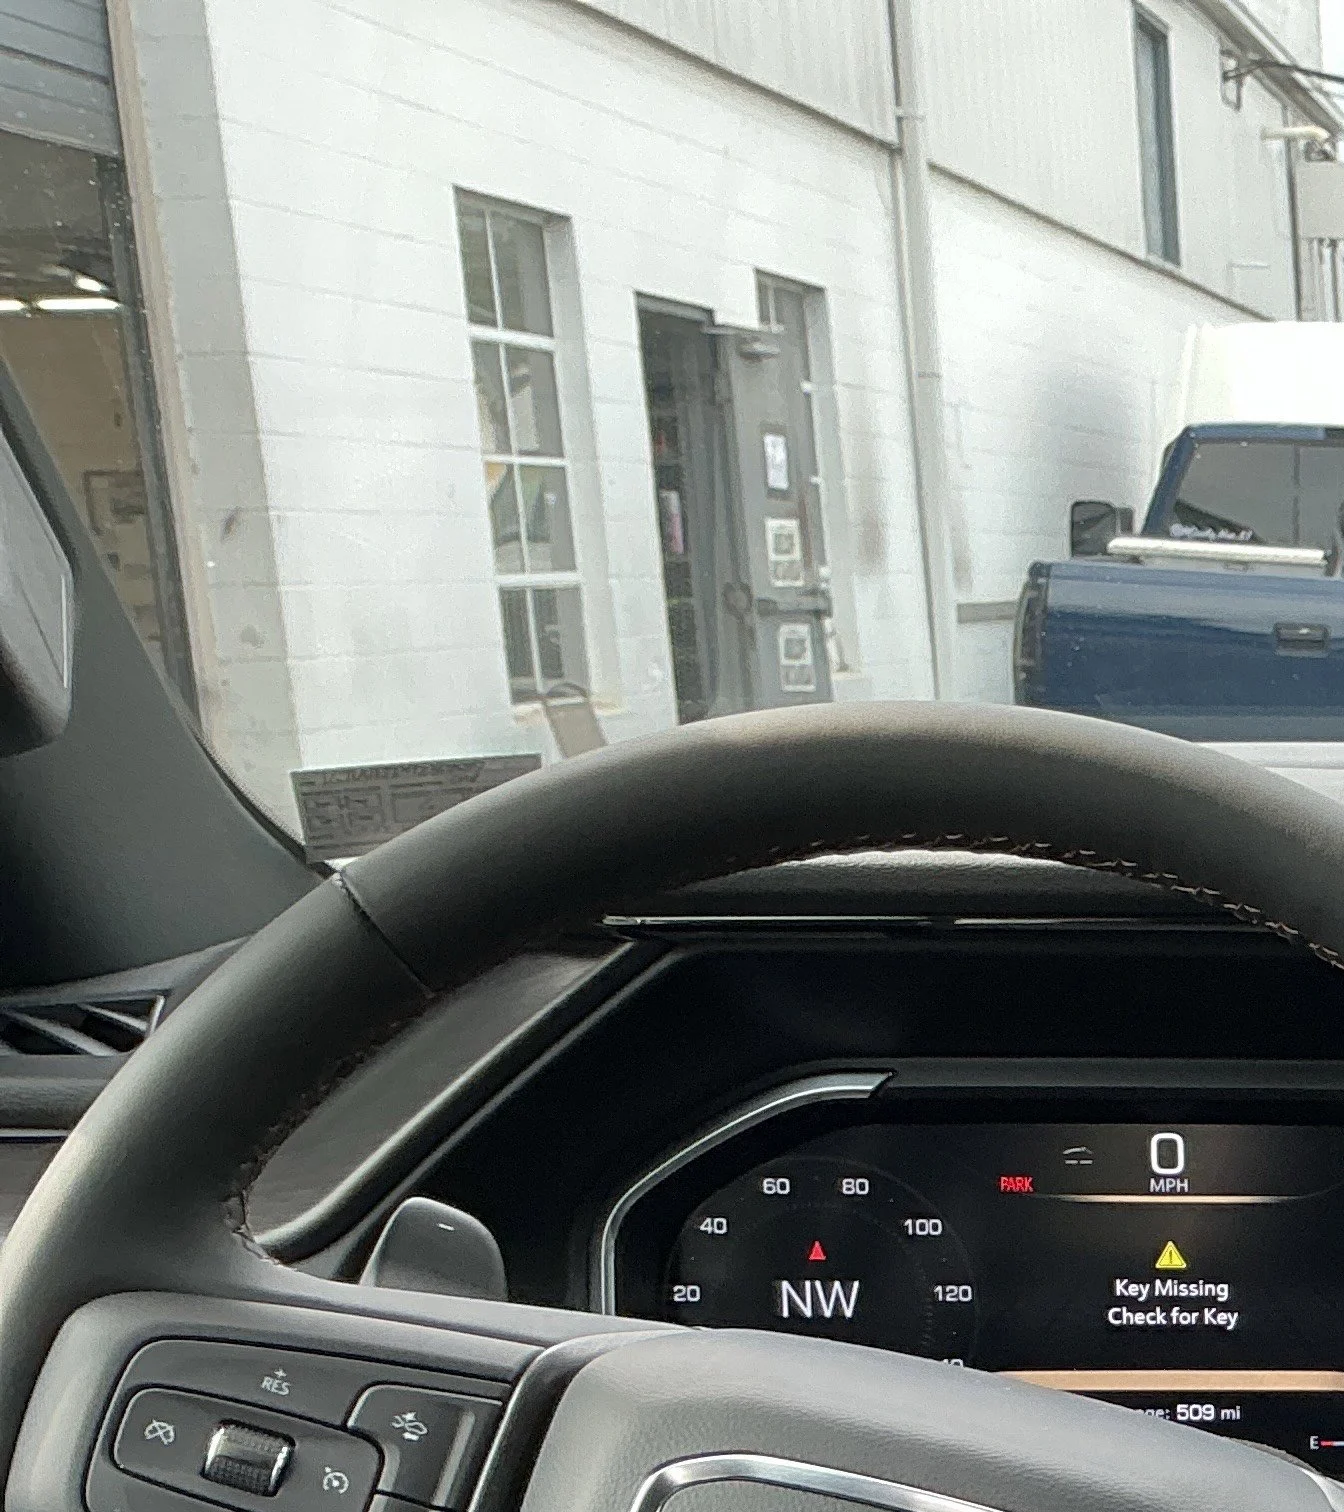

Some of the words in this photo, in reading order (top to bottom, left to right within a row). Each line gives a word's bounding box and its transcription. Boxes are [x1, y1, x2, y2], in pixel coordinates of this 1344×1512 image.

[1150, 1132, 1185, 1176] 0
[763, 1178, 790, 1195] 60
[842, 1178, 869, 1195] 80
[1000, 1176, 1034, 1193] PARK
[1150, 1178, 1189, 1193] MPH
[700, 1217, 727, 1234] 40
[904, 1218, 943, 1236] 100
[673, 1285, 700, 1302] 20
[933, 1285, 972, 1302] 120
[1115, 1278, 1150, 1301] Key
[1154, 1279, 1229, 1301] Missing
[781, 1280, 859, 1318] NW
[1108, 1307, 1166, 1326] Check
[1170, 1307, 1199, 1326] for
[1204, 1308, 1239, 1330] Key
[262, 1376, 291, 1396] RES
[1176, 1404, 1215, 1421] 509
[1220, 1405, 1241, 1421] mi
[1309, 1436, 1319, 1450] E
